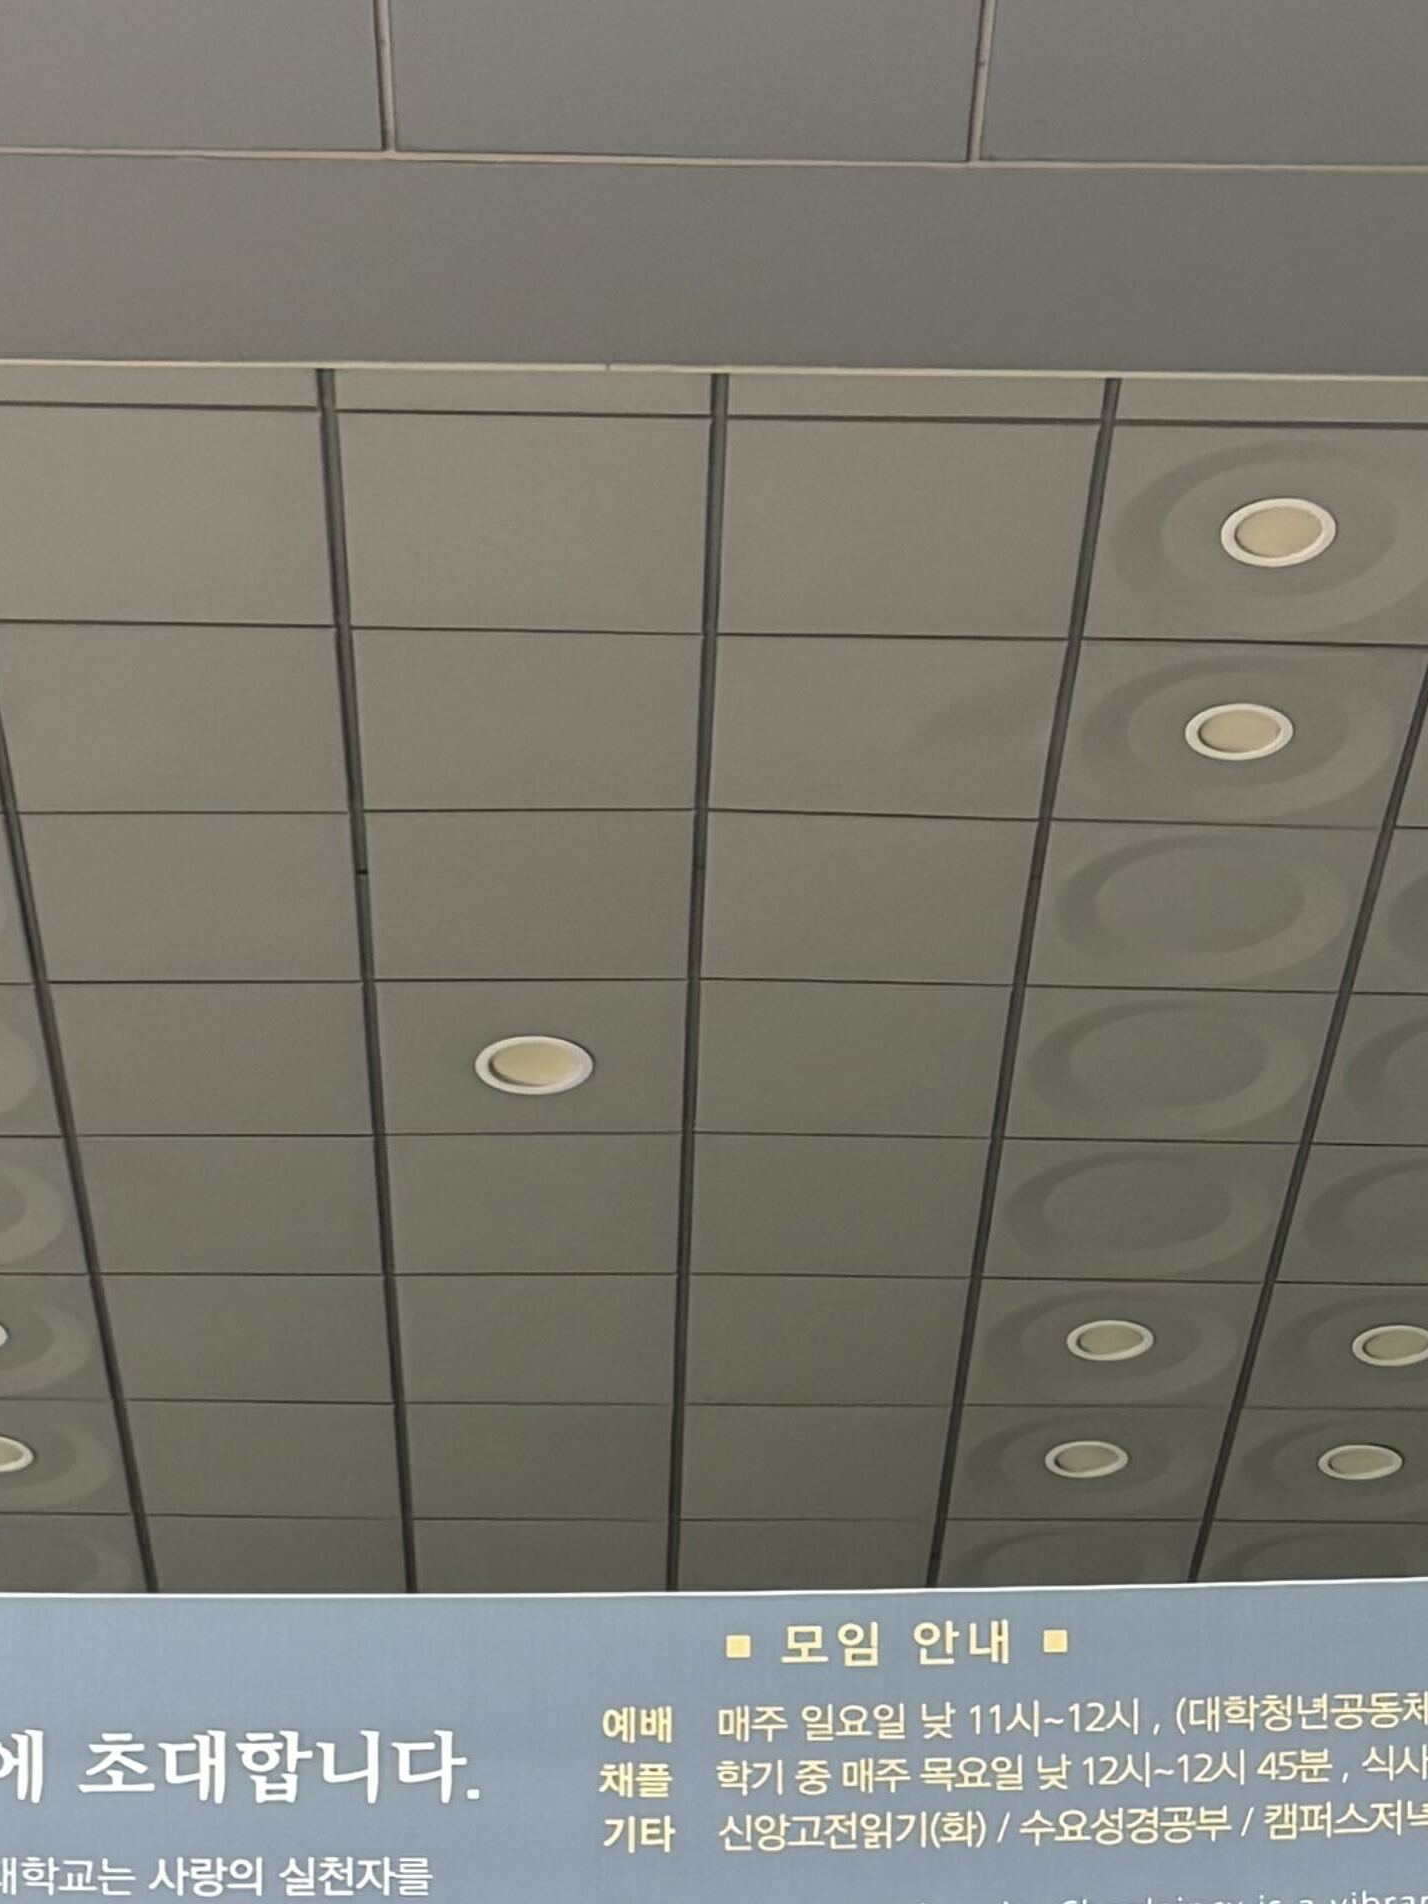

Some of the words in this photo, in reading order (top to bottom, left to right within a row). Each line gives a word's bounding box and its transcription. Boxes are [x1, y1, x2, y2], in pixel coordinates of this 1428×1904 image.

[781, 1621, 879, 1667] 모임
[913, 1618, 1009, 1665] 안내
[602, 1705, 672, 1744] 예배
[718, 1704, 789, 1743] 매주
[801, 1702, 906, 1741] 일요일
[921, 1701, 956, 1740] 낮
[969, 1697, 1139, 1738] 11시~12시
[78, 1729, 480, 1804] 초대합니다.
[598, 1761, 673, 1798] 채플
[716, 1759, 783, 1797] 학기
[799, 1759, 832, 1796] 중
[842, 1757, 912, 1794] 매주
[919, 1753, 1024, 1793] 목요일
[1037, 1753, 1072, 1791] 낮
[1082, 1748, 1245, 1789] 12시~12시
[1256, 1748, 1333, 1783] 45분
[603, 1815, 677, 1854] 기타
[718, 1810, 987, 1852] 신앙고전읽기(화)
[1019, 1805, 1233, 1847] 수요성경공부
[148, 1856, 263, 1898] 사랑의
[279, 1856, 434, 1897] 실천자를
